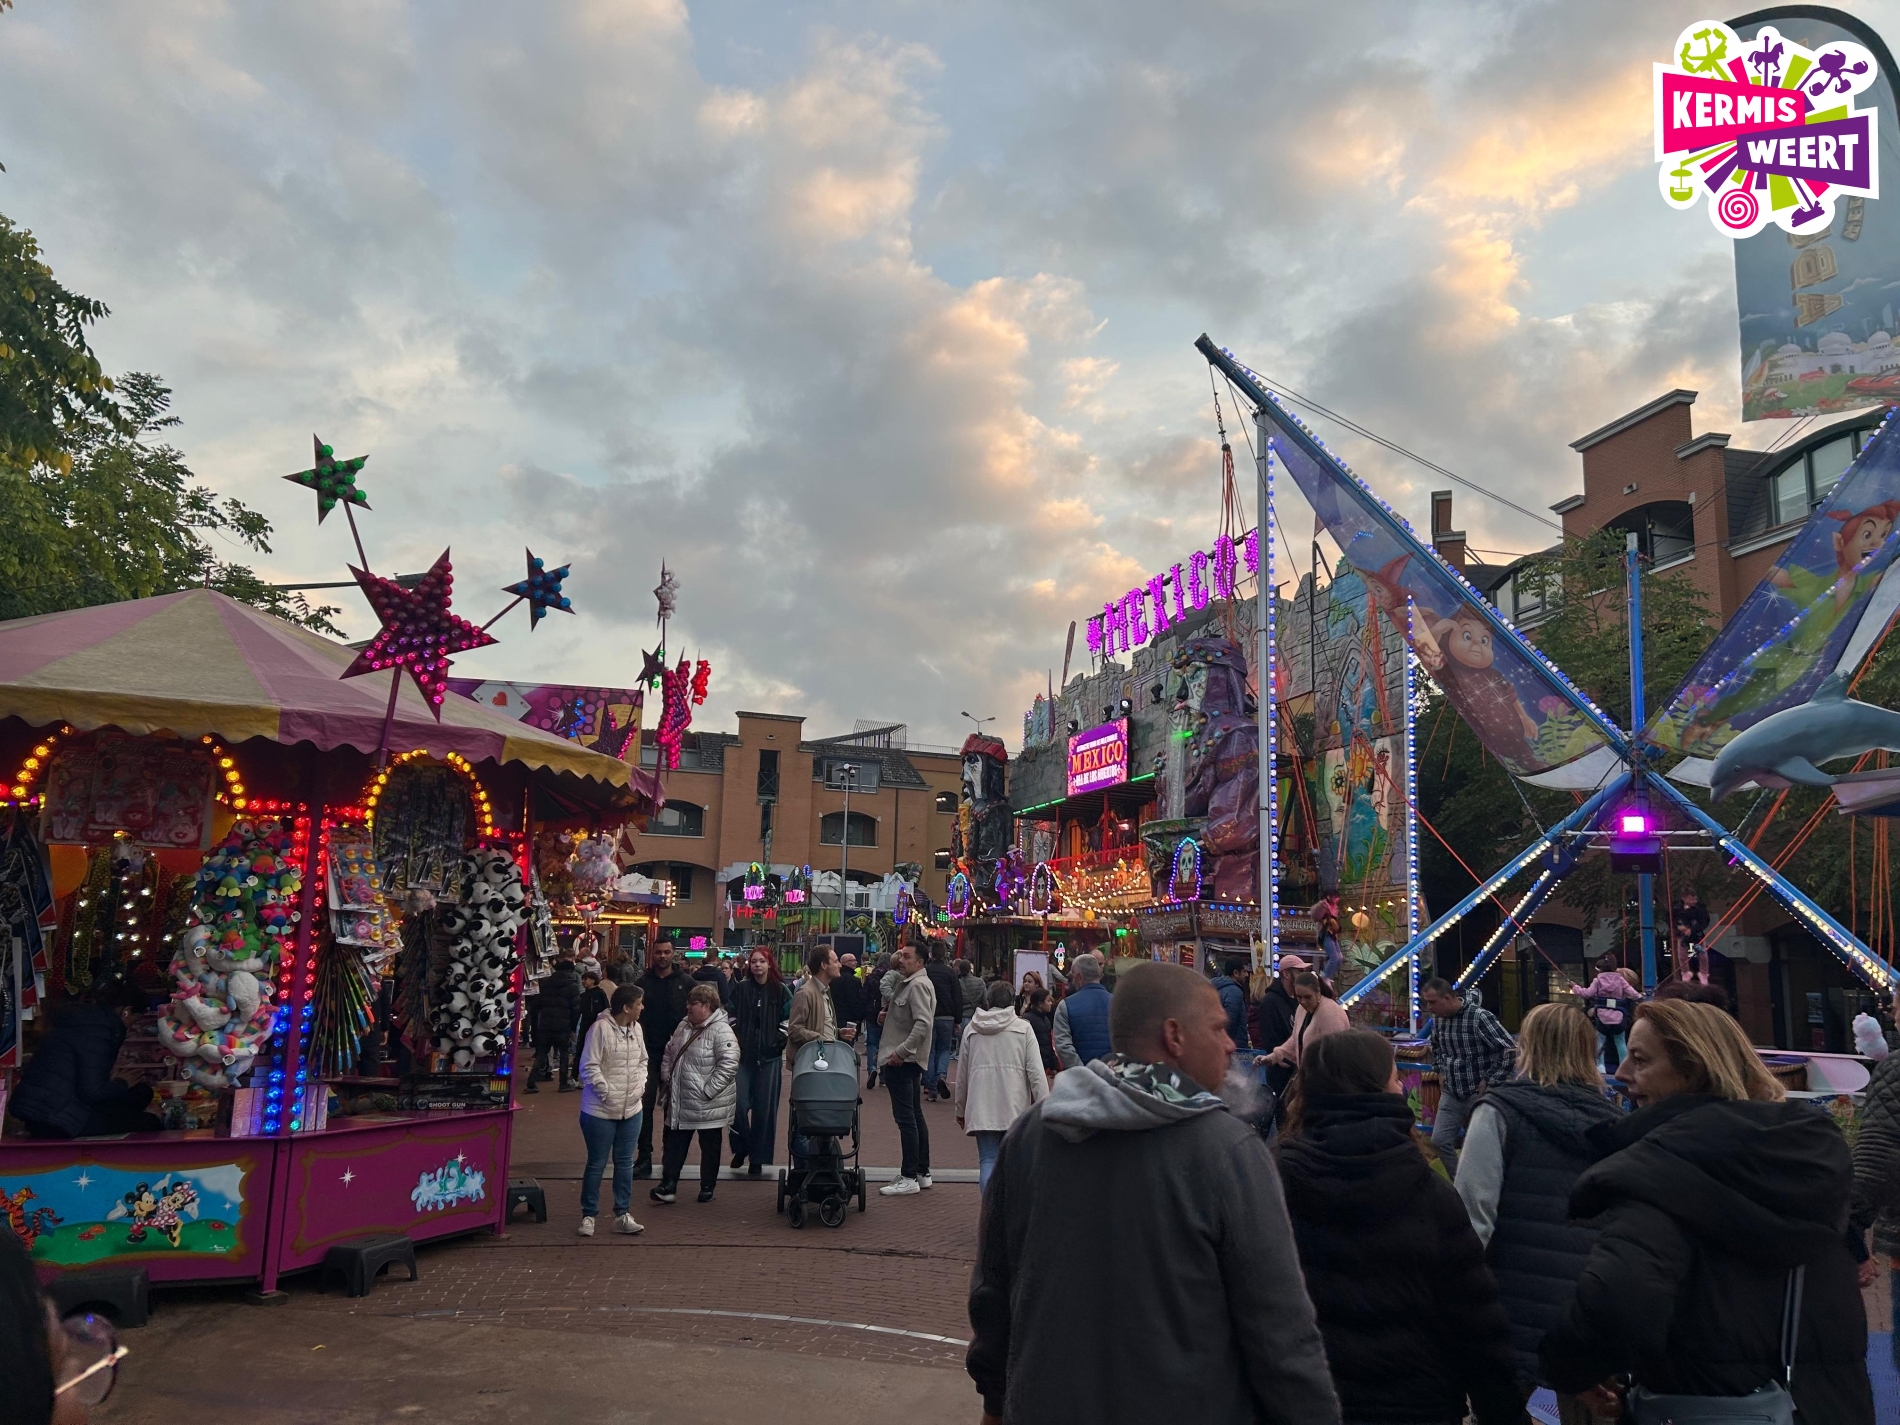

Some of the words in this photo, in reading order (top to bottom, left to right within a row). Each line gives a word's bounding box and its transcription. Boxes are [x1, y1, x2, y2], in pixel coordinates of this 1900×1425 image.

[1103, 534, 1239, 657] MEXICO
[1071, 740, 1124, 774] MEXICO
[785, 889, 805, 903] TOXIC
